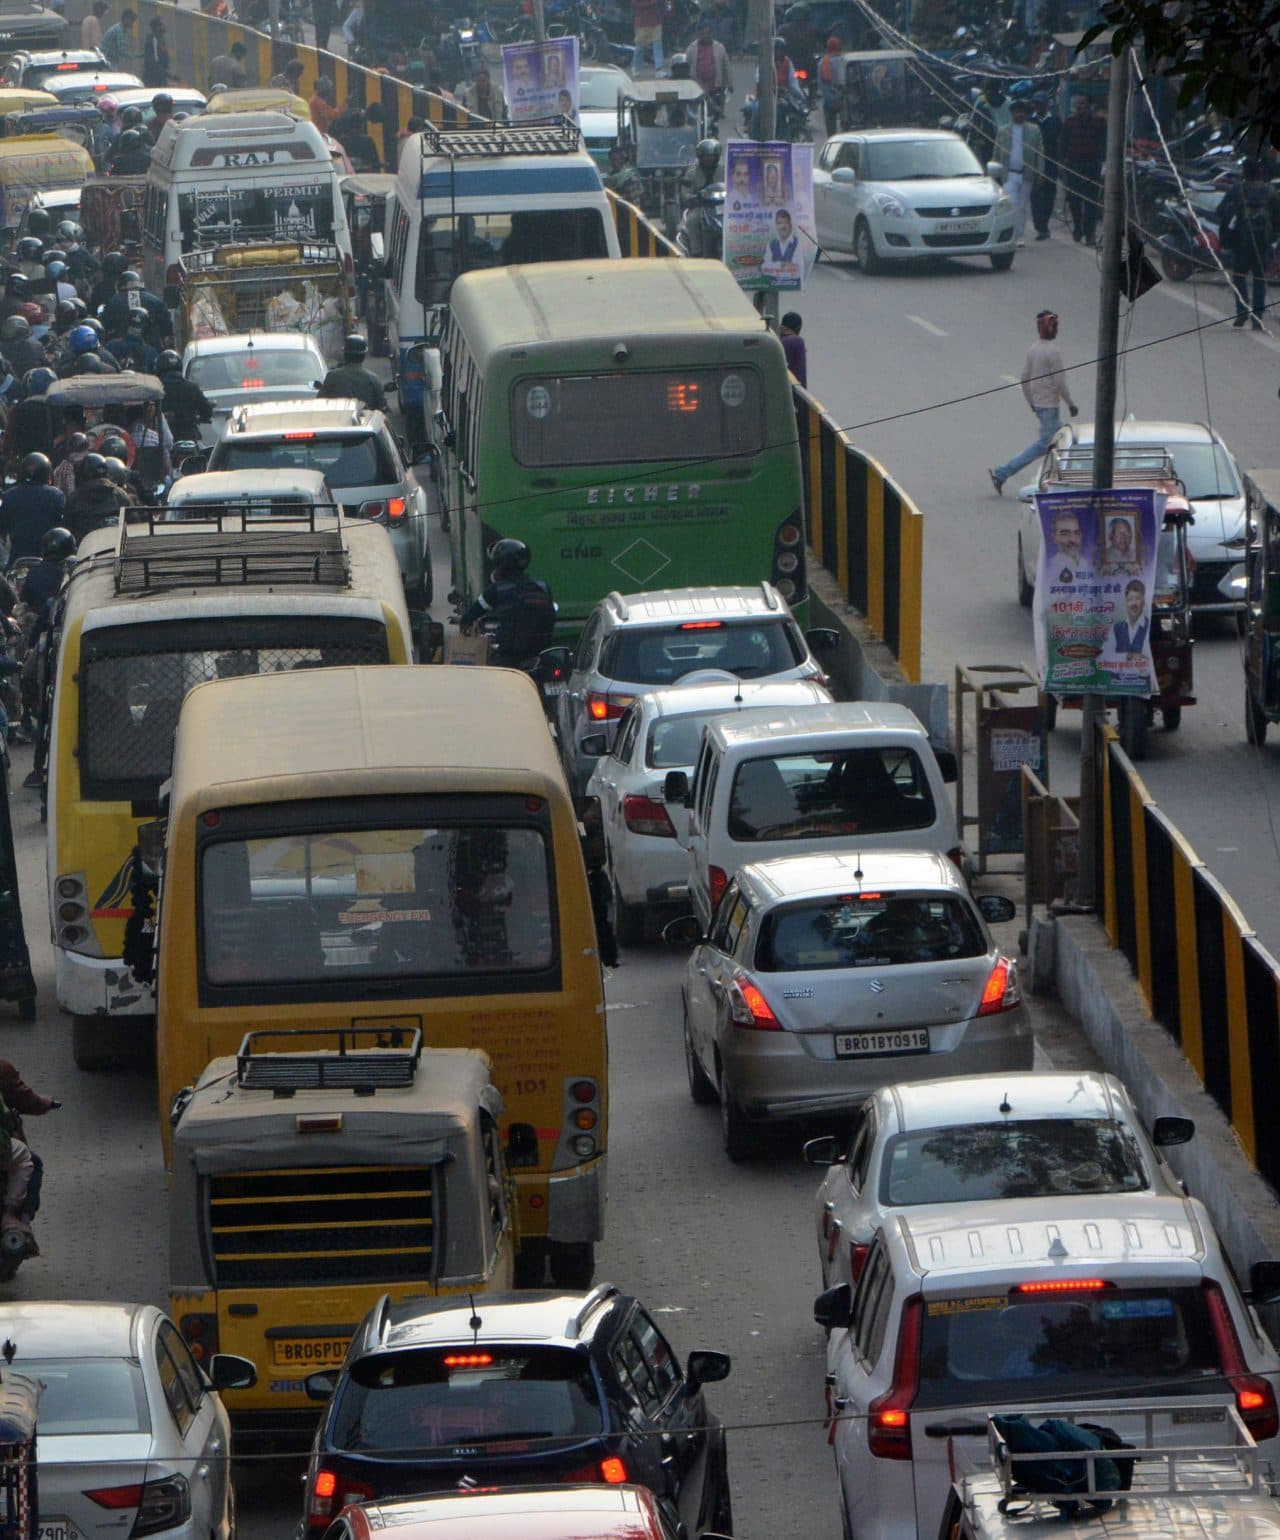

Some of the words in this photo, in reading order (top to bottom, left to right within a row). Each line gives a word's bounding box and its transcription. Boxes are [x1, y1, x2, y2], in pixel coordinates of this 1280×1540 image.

[224, 152, 276, 167] RAJ
[187, 191, 246, 204] TOURIST
[263, 185, 322, 199] PERMIT
[587, 485, 702, 503] EICHER
[516, 1080, 547, 1096] 101
